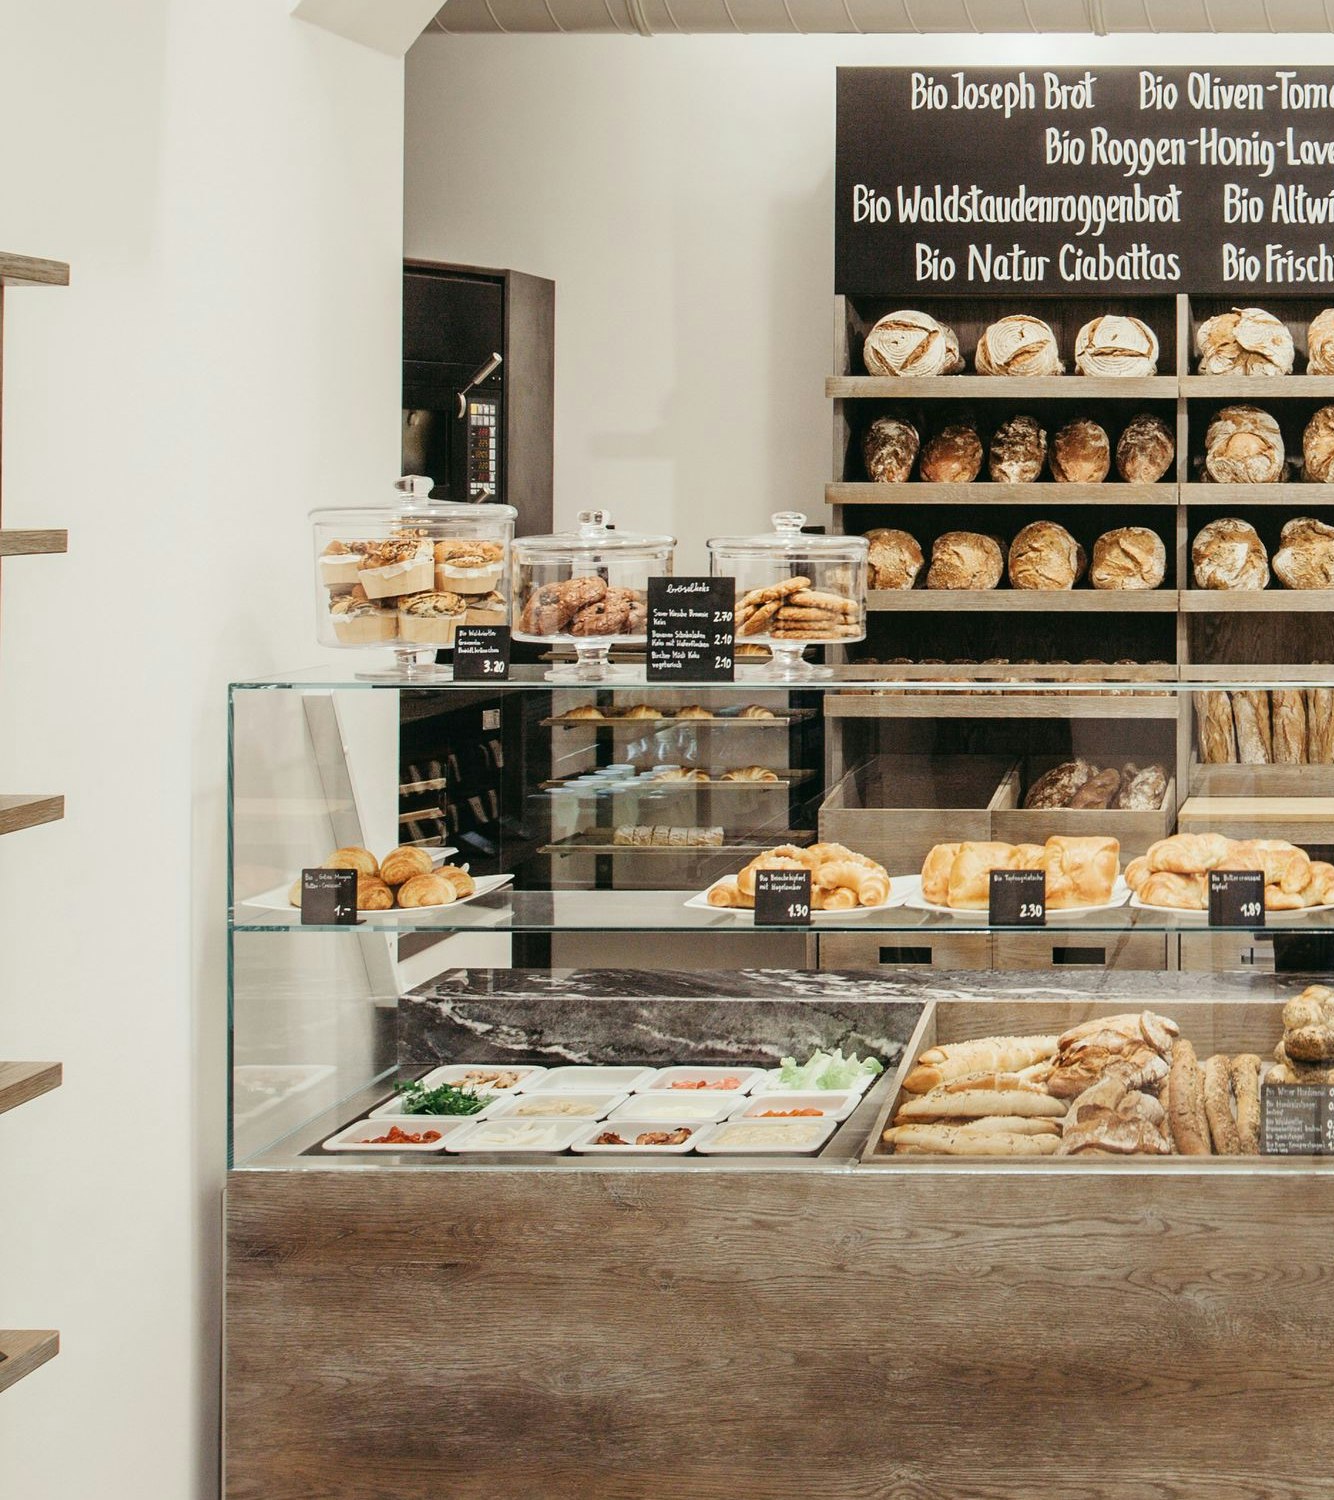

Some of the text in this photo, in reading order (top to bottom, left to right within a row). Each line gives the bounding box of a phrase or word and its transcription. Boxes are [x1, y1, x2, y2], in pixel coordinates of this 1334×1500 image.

[912, 71, 1098, 118] Bio Joseph Brot
[1139, 71, 1178, 110] Bio
[1046, 127, 1085, 165] Bio
[854, 183, 1182, 236] Bio Waldstaudenroggenbrot
[1224, 184, 1263, 223] Bio
[916, 243, 1180, 282] Bio Natur Ciabattas
[1223, 243, 1260, 281] Bio
[713, 611, 733, 622] 2.70
[714, 634, 733, 645] 2.10
[483, 660, 505, 673] 3.20
[715, 656, 731, 669] 2.10
[788, 904, 808, 917] 1.30
[1020, 903, 1042, 917] 2.30
[1240, 902, 1261, 917] 1.89
